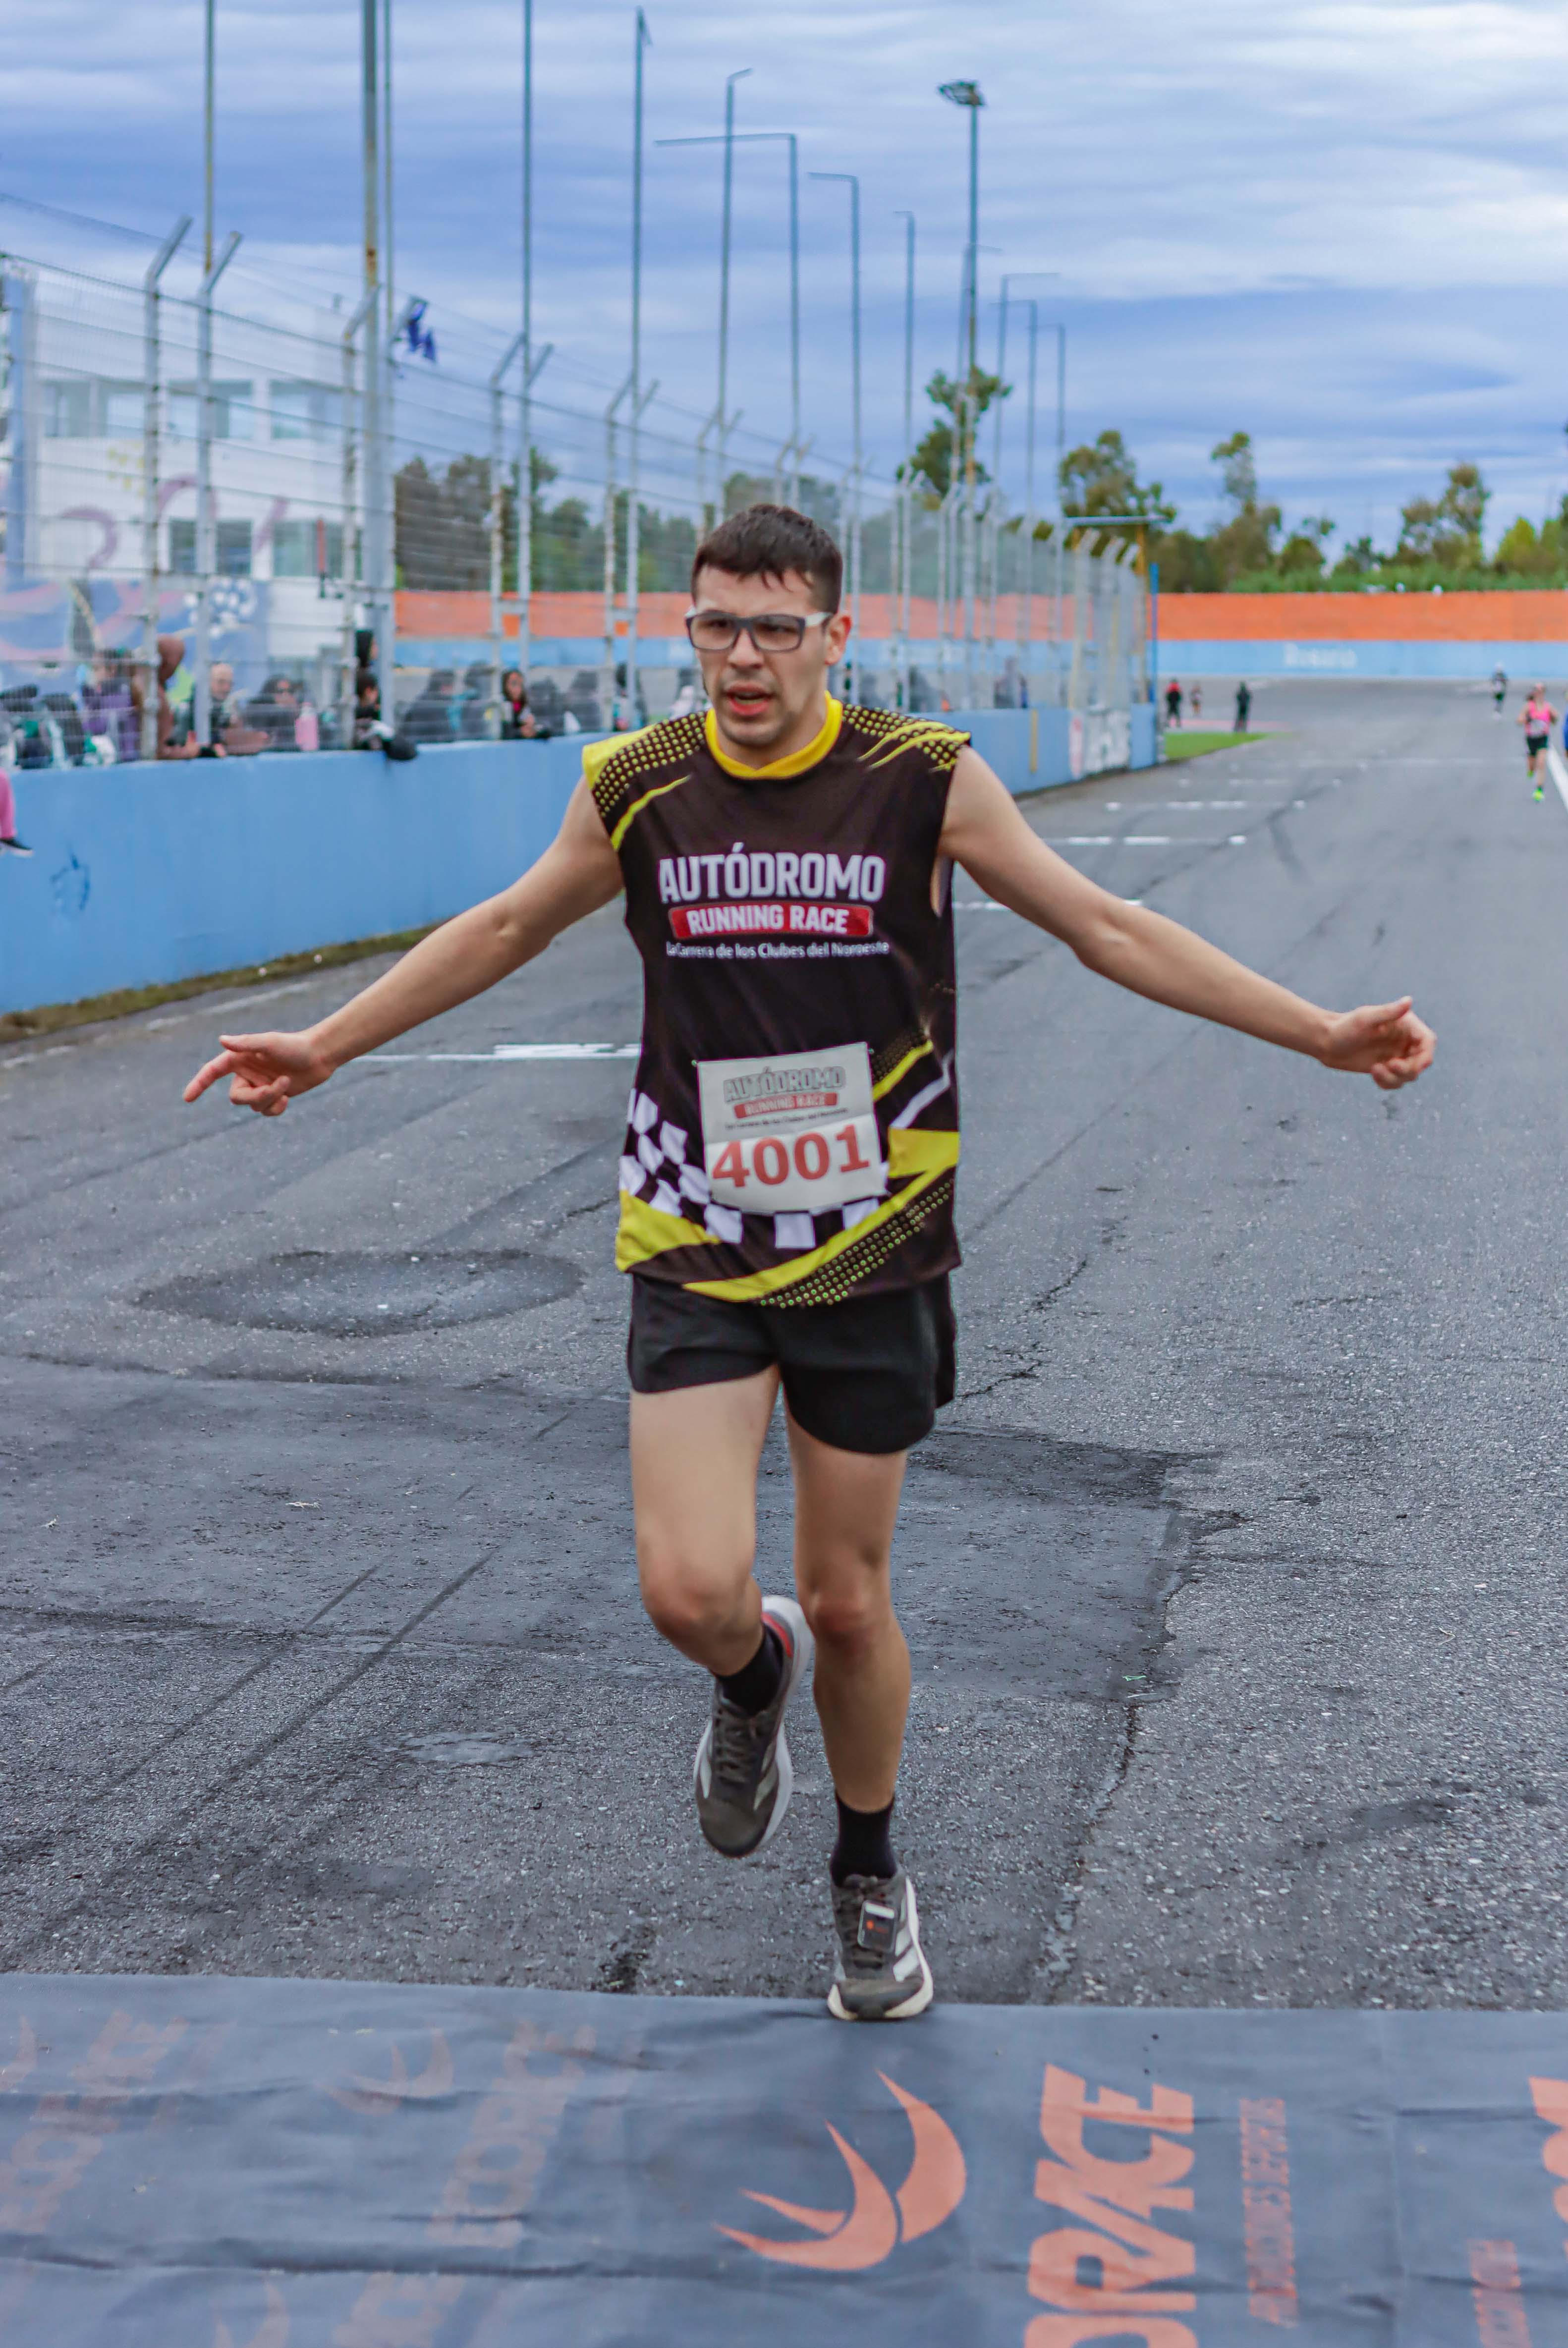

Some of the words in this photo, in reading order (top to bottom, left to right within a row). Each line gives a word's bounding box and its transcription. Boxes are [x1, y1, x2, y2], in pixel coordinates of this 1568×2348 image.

[659, 842, 886, 903] AUTÓDROMO
[686, 905, 784, 935] RUNNING
[789, 905, 850, 934] RACE
[716, 943, 734, 959] de
[735, 943, 757, 958] los
[757, 942, 806, 958] Clubes
[806, 942, 830, 957] del
[724, 1066, 845, 1103] AUTÓDROMO
[712, 1124, 870, 1188] 4001
